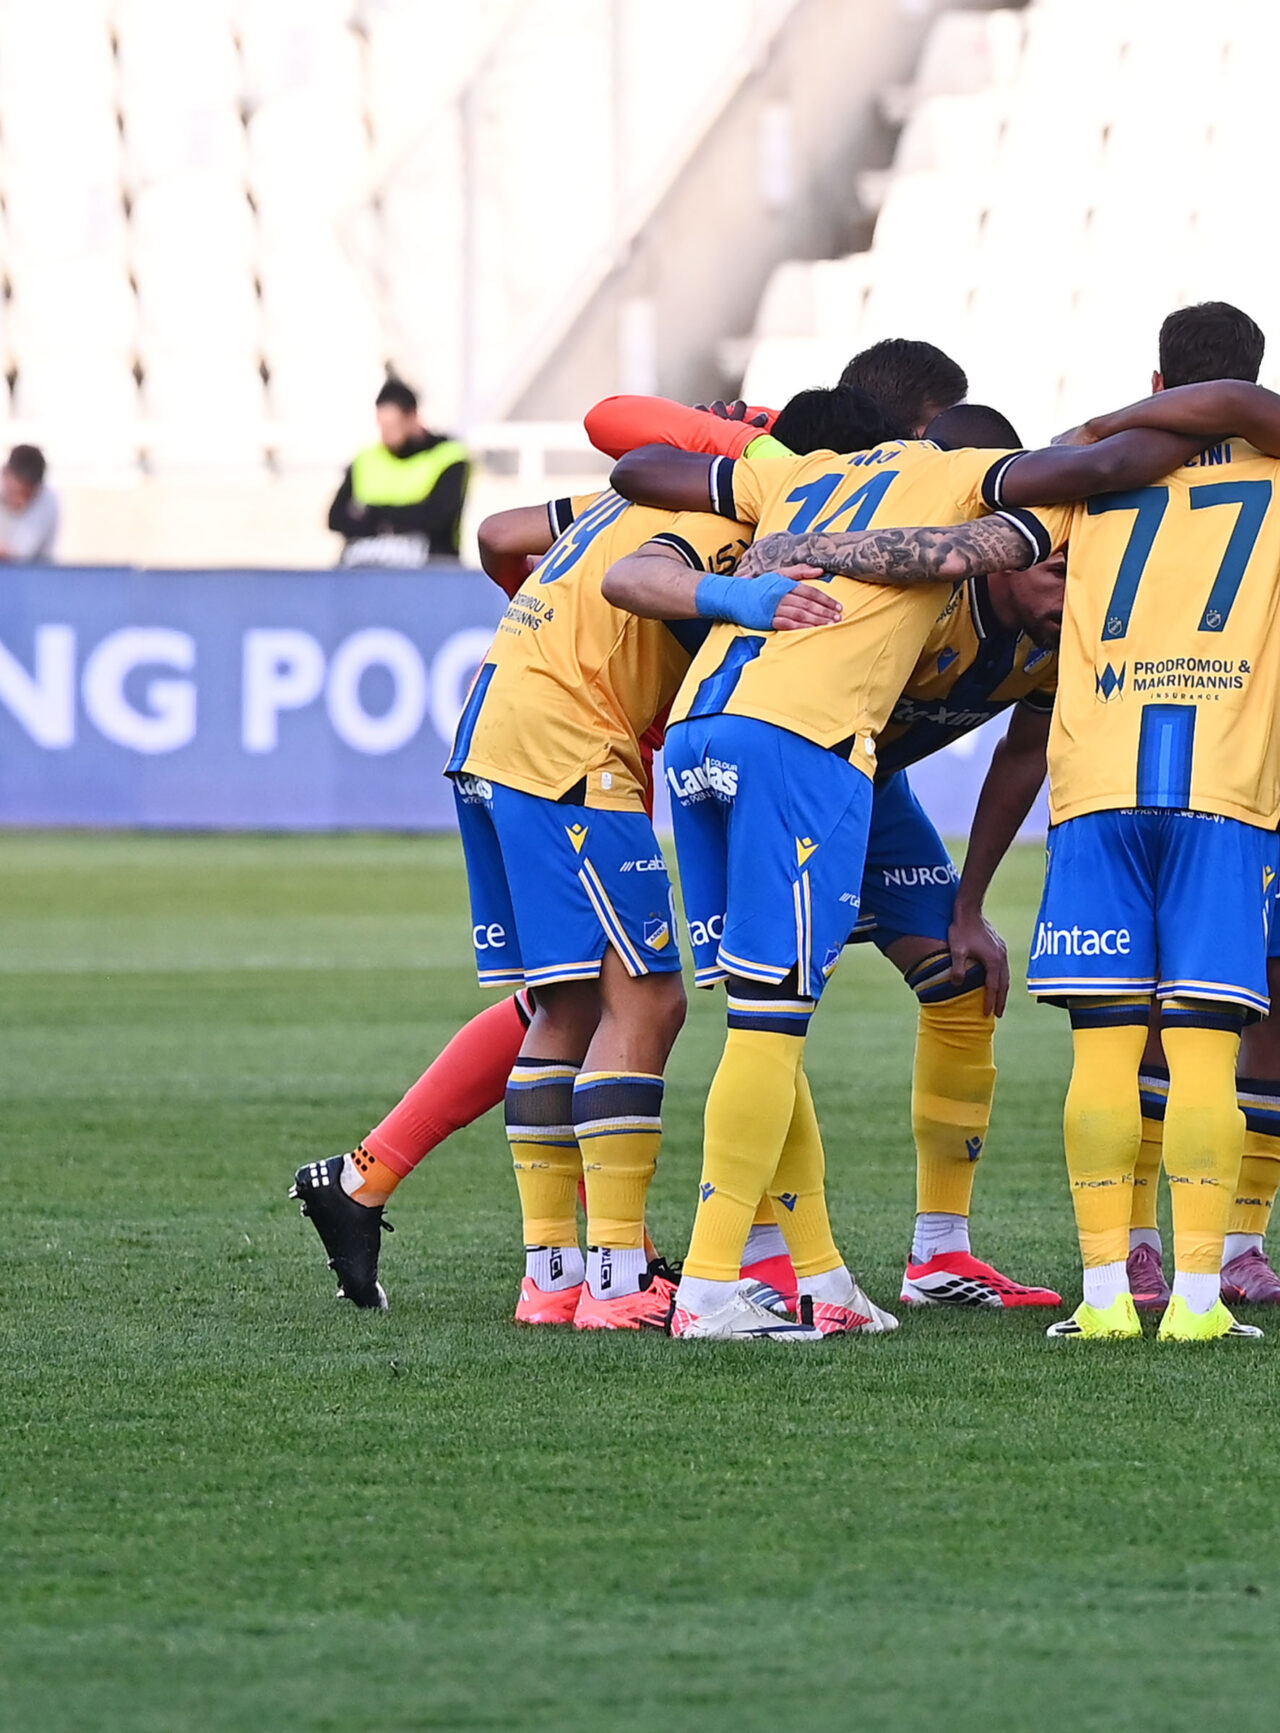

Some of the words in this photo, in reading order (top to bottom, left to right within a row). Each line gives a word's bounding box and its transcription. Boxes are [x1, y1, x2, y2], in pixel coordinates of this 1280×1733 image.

[1086, 480, 1273, 642] 77
[1134, 657, 1234, 675] PRODROMOU
[1238, 659, 1252, 674] &
[1133, 673, 1244, 692] MAKRIYIANNIS
[1150, 692, 1220, 701] INSURANCE
